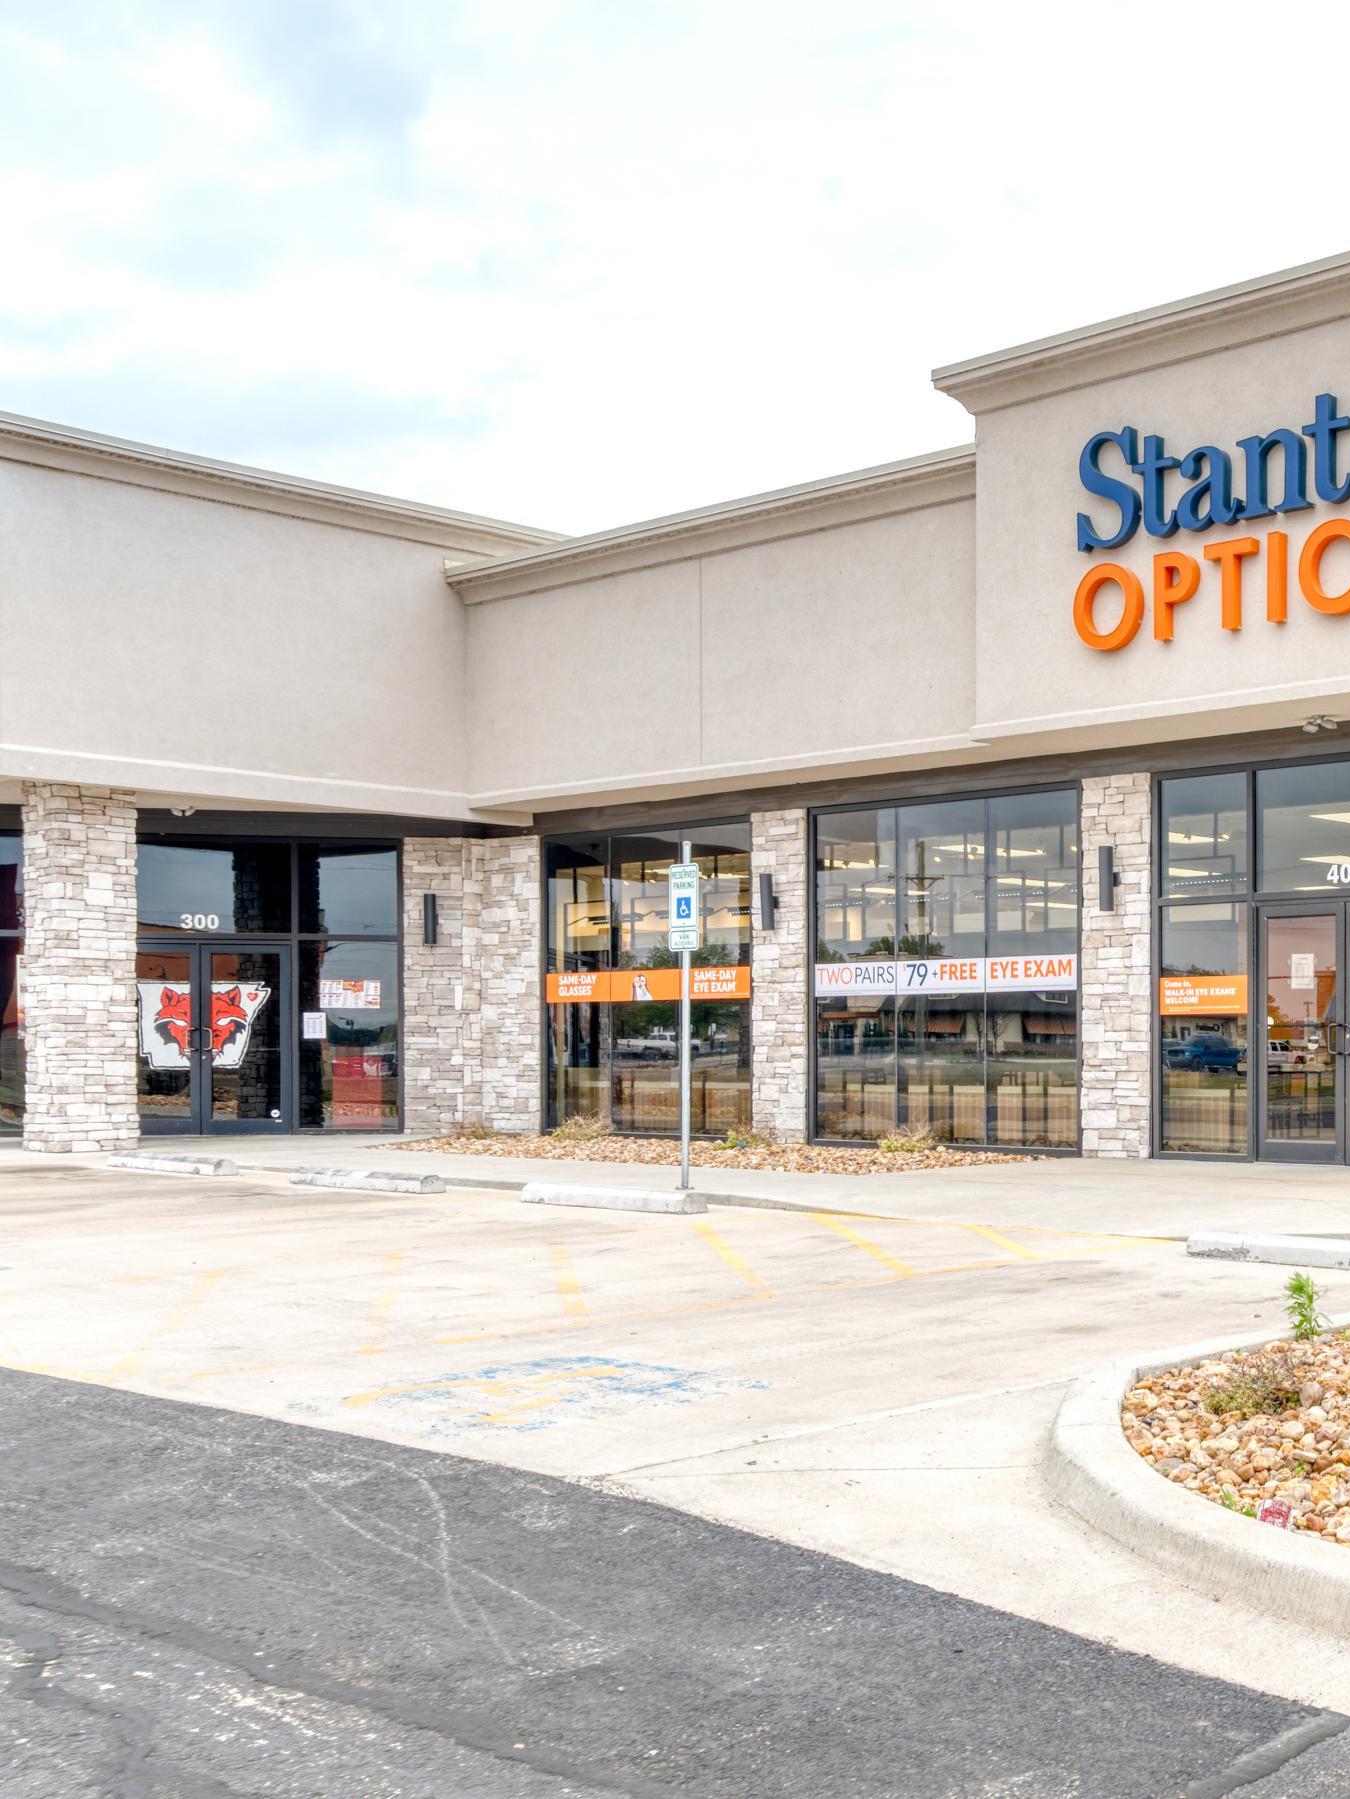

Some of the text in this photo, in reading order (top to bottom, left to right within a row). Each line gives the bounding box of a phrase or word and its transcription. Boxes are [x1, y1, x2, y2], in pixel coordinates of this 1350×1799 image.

[671, 869, 696, 880] RESERVED
[673, 881, 695, 891] PARKING
[179, 913, 220, 930] 300
[694, 969, 737, 981] SAME-DAY
[816, 966, 853, 985] TWO
[854, 965, 895, 984] PAIRS
[902, 962, 929, 987] $79
[990, 960, 1019, 980] EYE
[558, 974, 597, 985] SAME-DAY
[1164, 980, 1182, 988] Come
[694, 982, 709, 993] EYE
[1164, 988, 1194, 997] WALK-IN
[1195, 988, 1208, 996] EYE
[1164, 996, 1199, 1004] WELCOME
